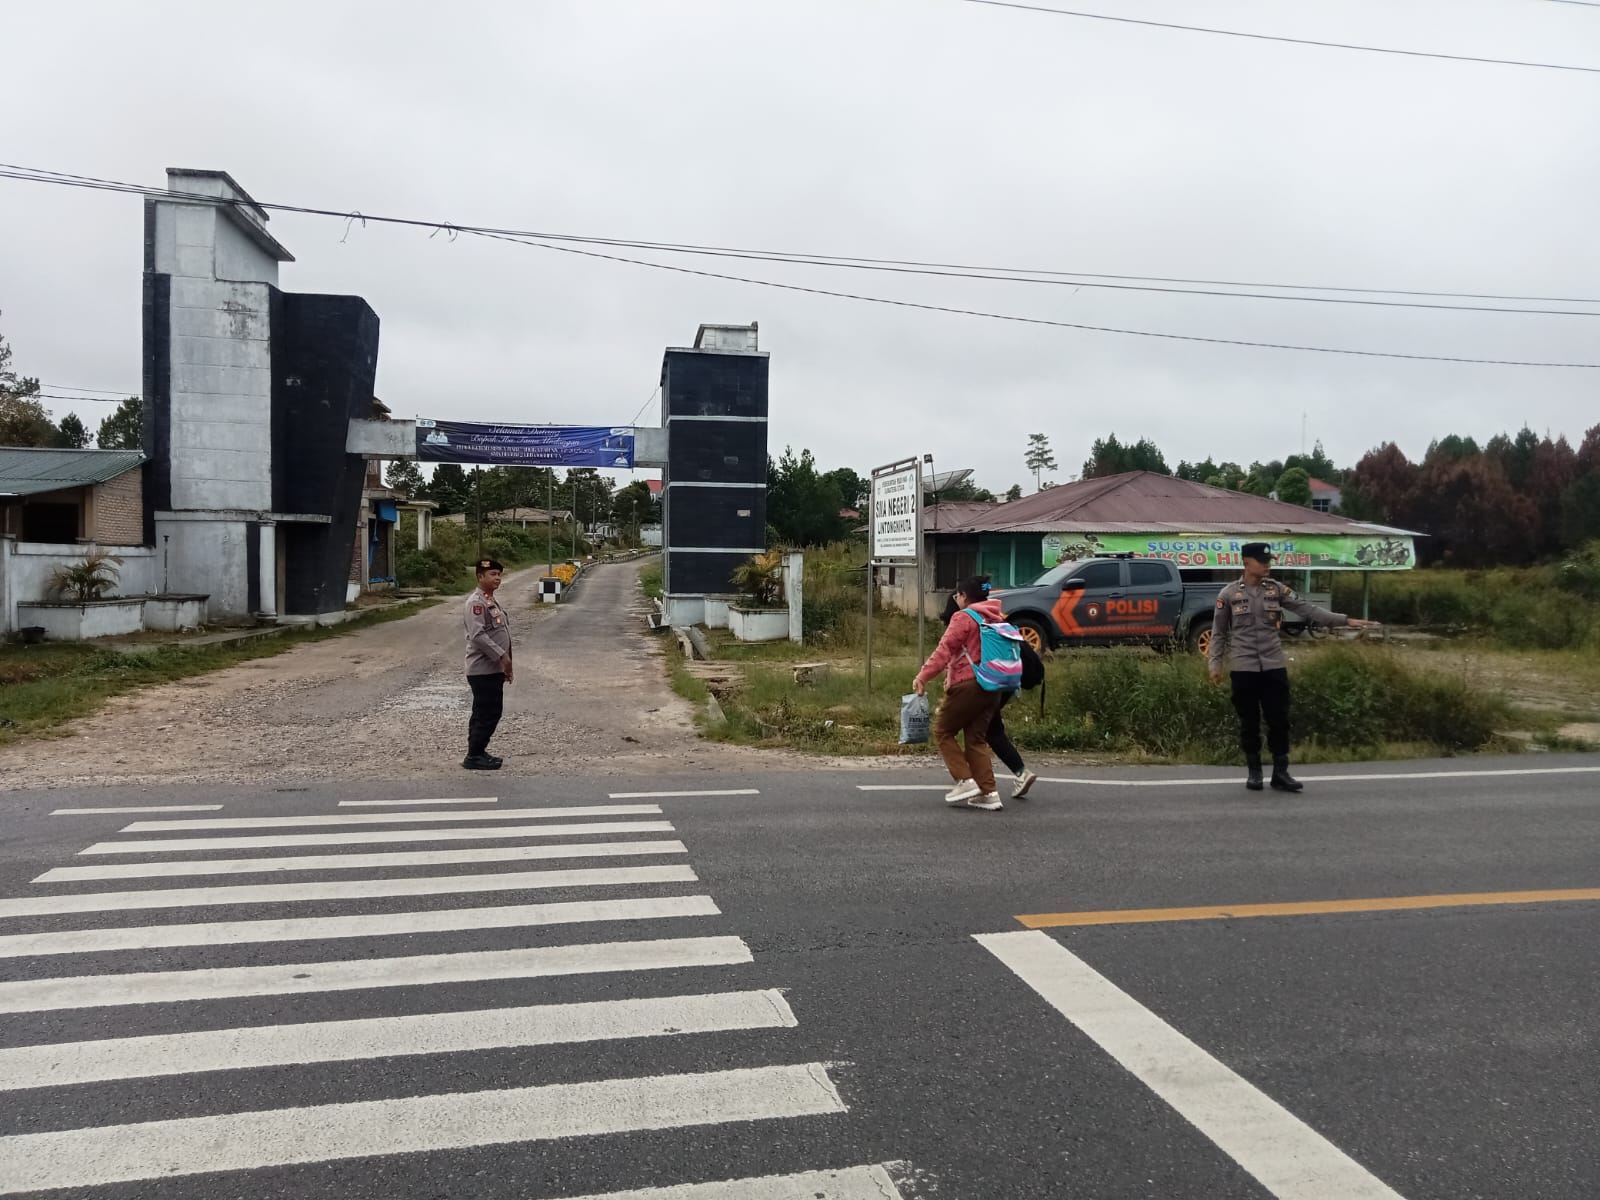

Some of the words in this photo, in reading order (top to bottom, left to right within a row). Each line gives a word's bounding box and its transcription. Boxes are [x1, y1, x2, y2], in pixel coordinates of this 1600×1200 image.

[876, 500, 887, 518] SMA
[888, 495, 909, 516] NEGERI
[911, 494, 915, 514] 2
[1147, 541, 1222, 552] SUGENG
[1230, 541, 1294, 552] RUH
[1217, 552, 1311, 565] HIYAH
[1105, 599, 1159, 614] POLISI
